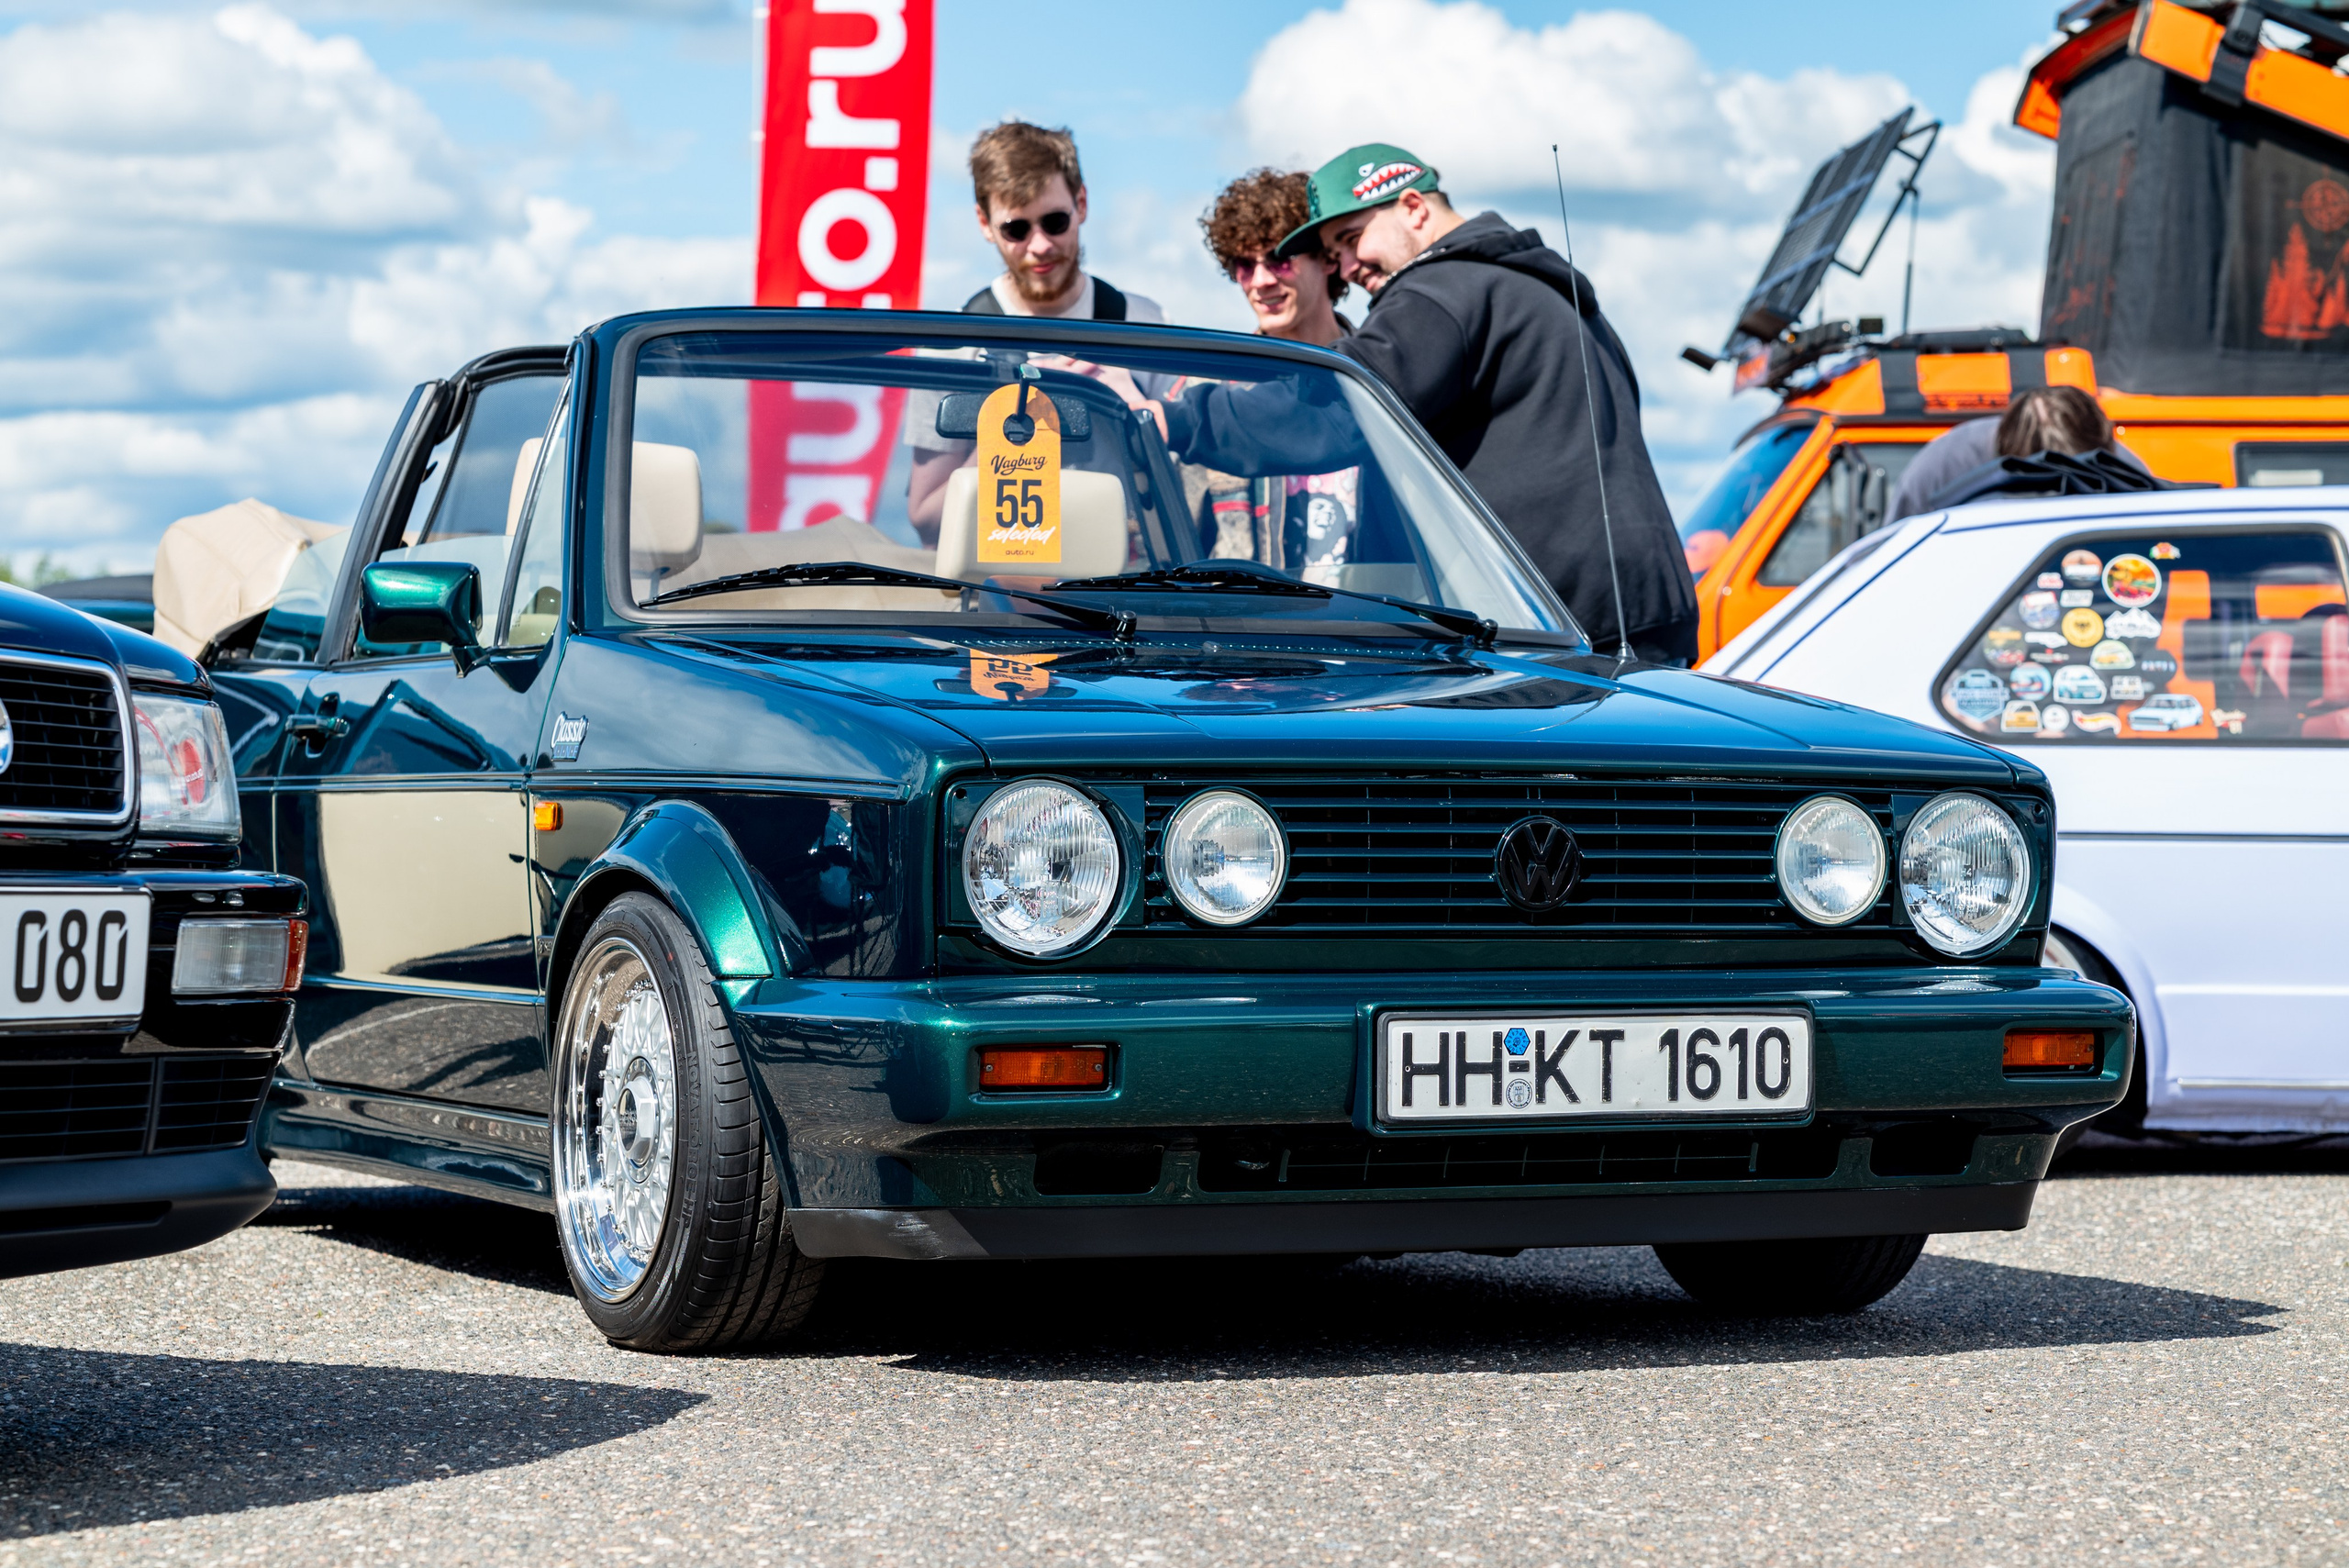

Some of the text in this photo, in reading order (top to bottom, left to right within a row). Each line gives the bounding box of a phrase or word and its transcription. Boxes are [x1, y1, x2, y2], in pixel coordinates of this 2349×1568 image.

[778, 0, 907, 532] auo.ru
[990, 453, 1048, 476] Vagburg
[996, 479, 1043, 528] 55
[987, 522, 1056, 545] selected
[551, 713, 587, 749] Classic
[15, 908, 128, 1004] 080
[1658, 1025, 1792, 1103] 1610
